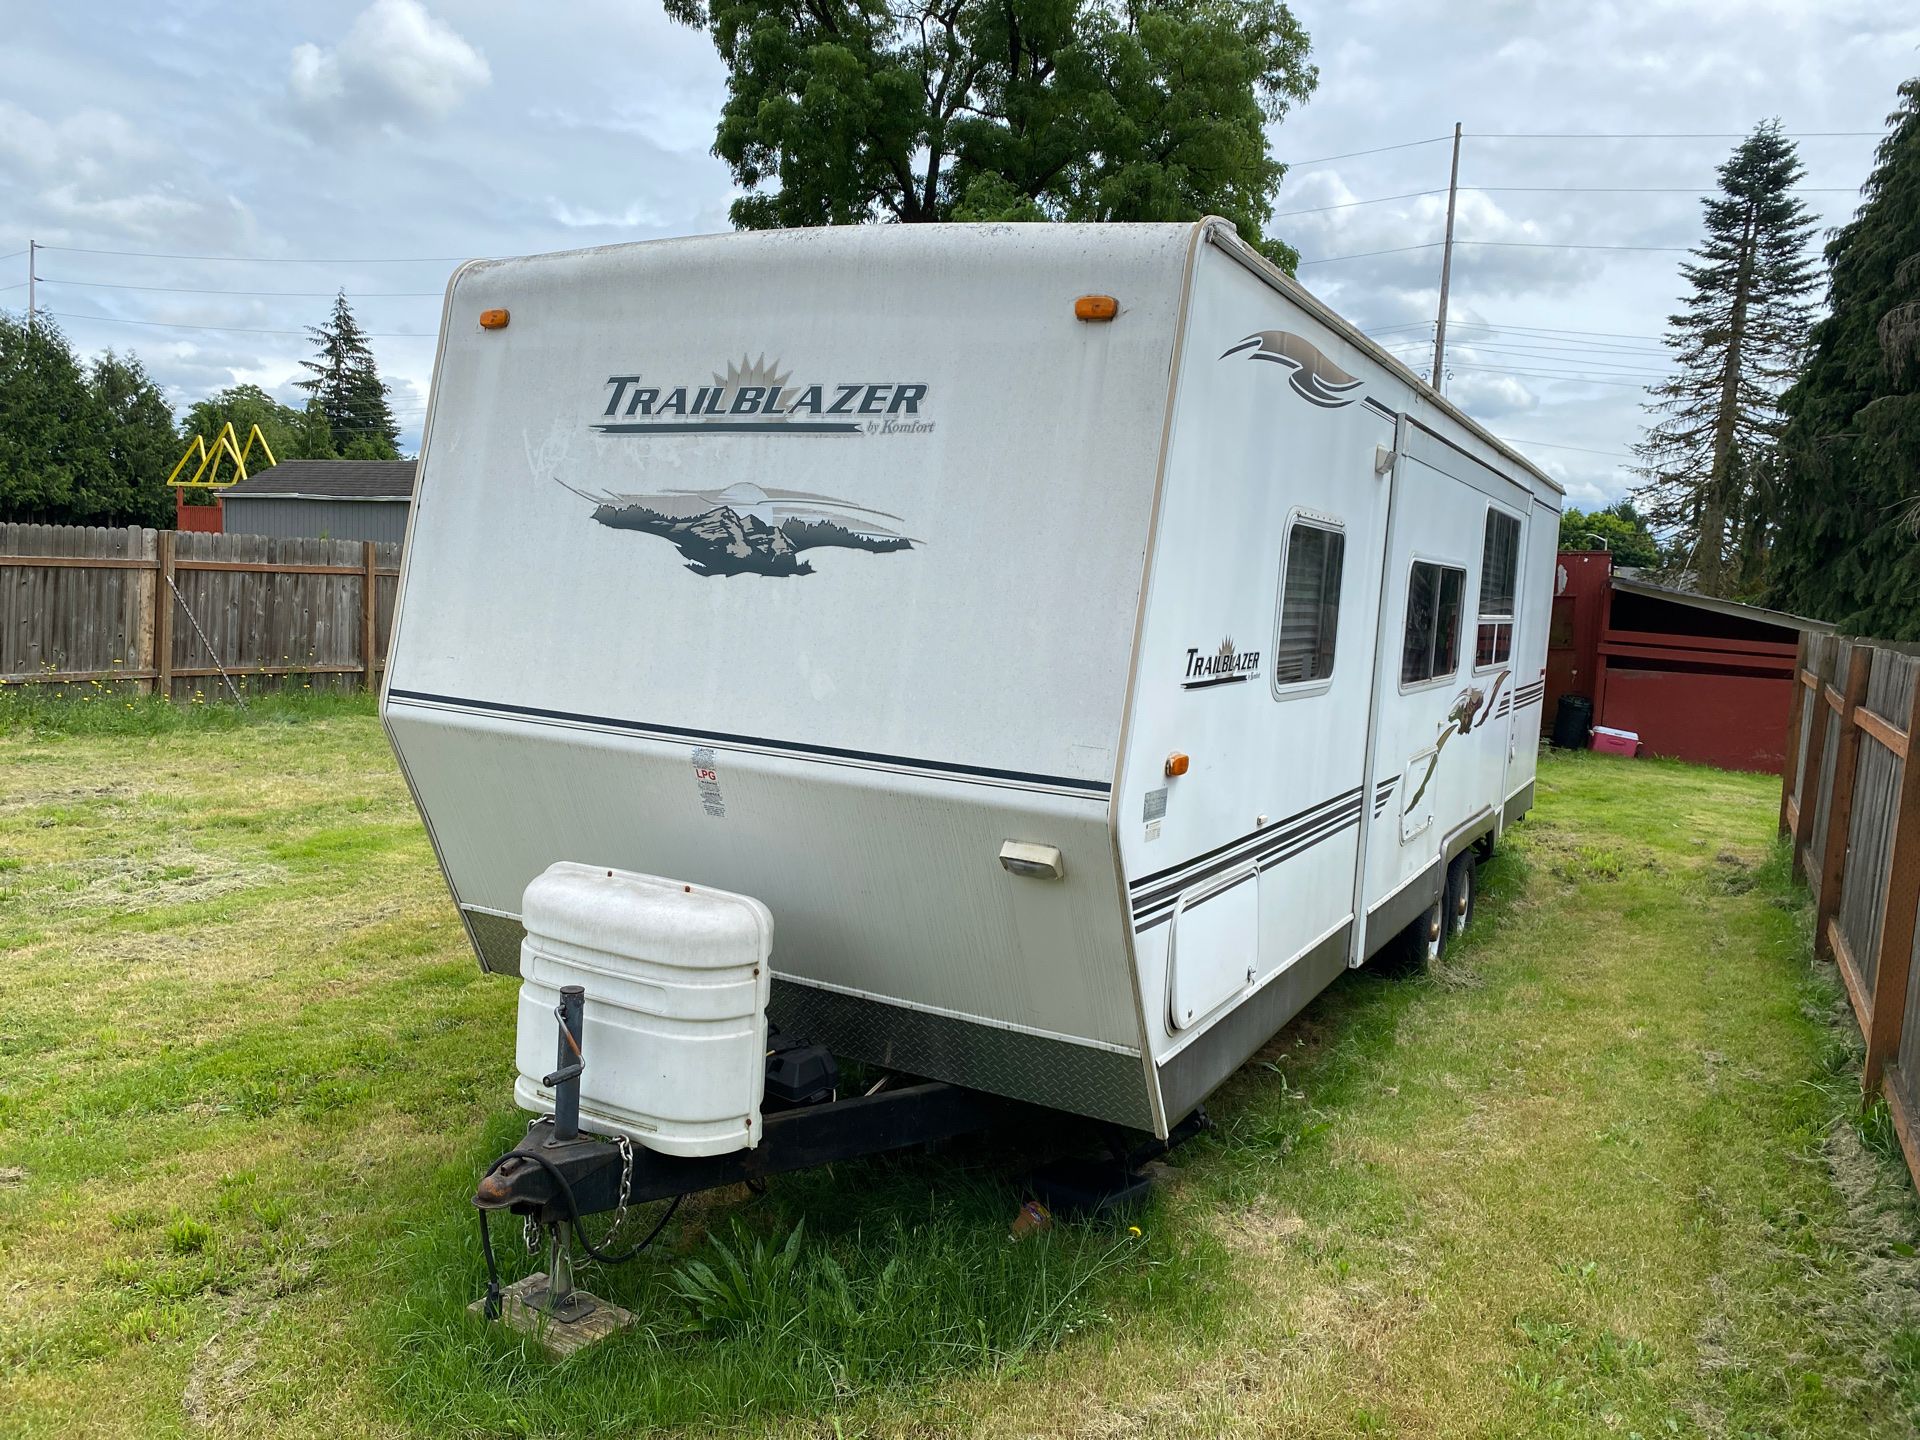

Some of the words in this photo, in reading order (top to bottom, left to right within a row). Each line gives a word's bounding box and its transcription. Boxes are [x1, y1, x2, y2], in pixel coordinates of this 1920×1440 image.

[603, 376, 929, 416] TRAILBLAZER
[867, 420, 880, 434] by
[880, 419, 935, 434] Komfort
[1186, 648, 1260, 676] TRAILBLAZER
[696, 768, 716, 780] LPG
